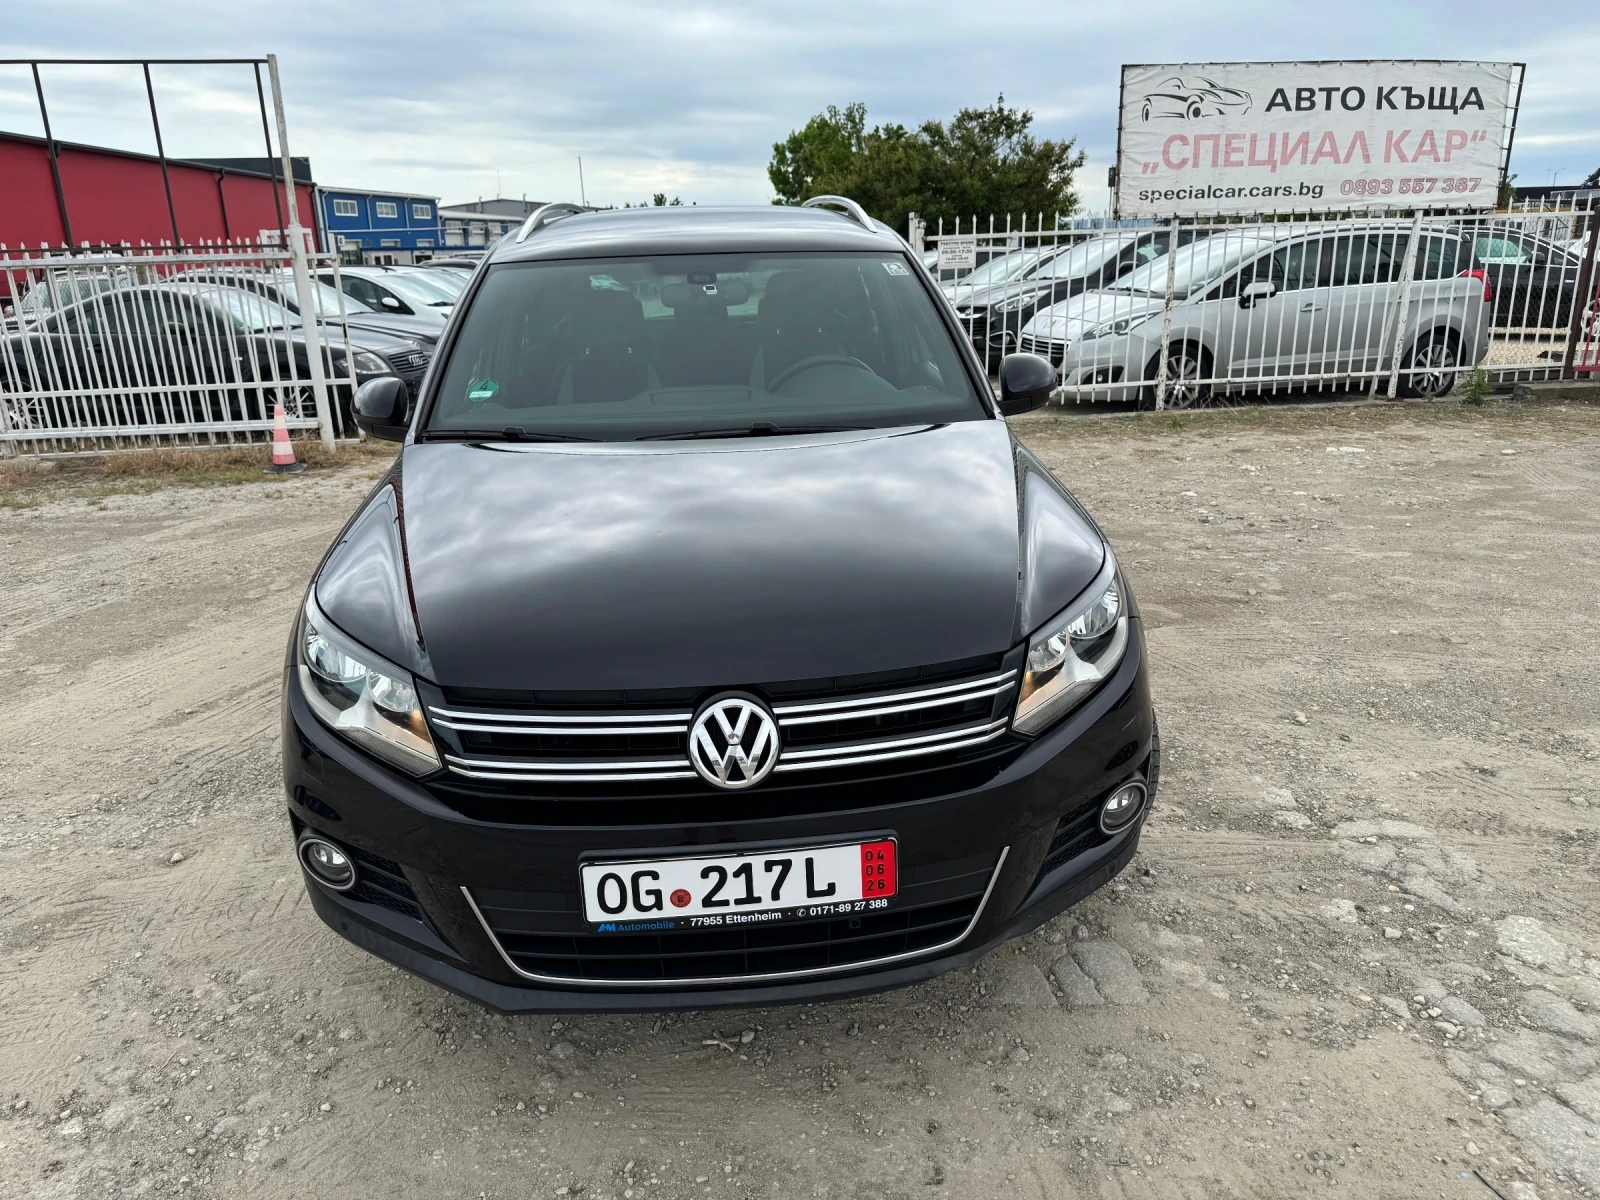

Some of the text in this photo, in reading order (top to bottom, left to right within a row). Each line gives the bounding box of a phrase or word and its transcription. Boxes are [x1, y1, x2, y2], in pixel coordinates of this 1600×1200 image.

[1265, 86, 1485, 115] АВТО КЪЩА
[1141, 129, 1487, 174] „СПЕЦИАЛ КАР“
[1138, 181, 1324, 202] specialcar.cars.bg
[1340, 177, 1482, 196] 0893 557 367
[480, 380, 489, 391] 4
[690, 698, 779, 789] VW
[865, 849, 885, 861] 04
[865, 863, 885, 877] 06
[597, 870, 664, 915] OG
[700, 859, 793, 908] 217
[805, 857, 836, 899] L
[866, 878, 886, 891] 26
[618, 920, 675, 931] Automobile
[690, 916, 724, 927] 77955
[726, 911, 782, 925] Ettenheim
[810, 904, 852, 916] 0171-89
[855, 901, 867, 911] 27
[869, 898, 890, 909] 388
